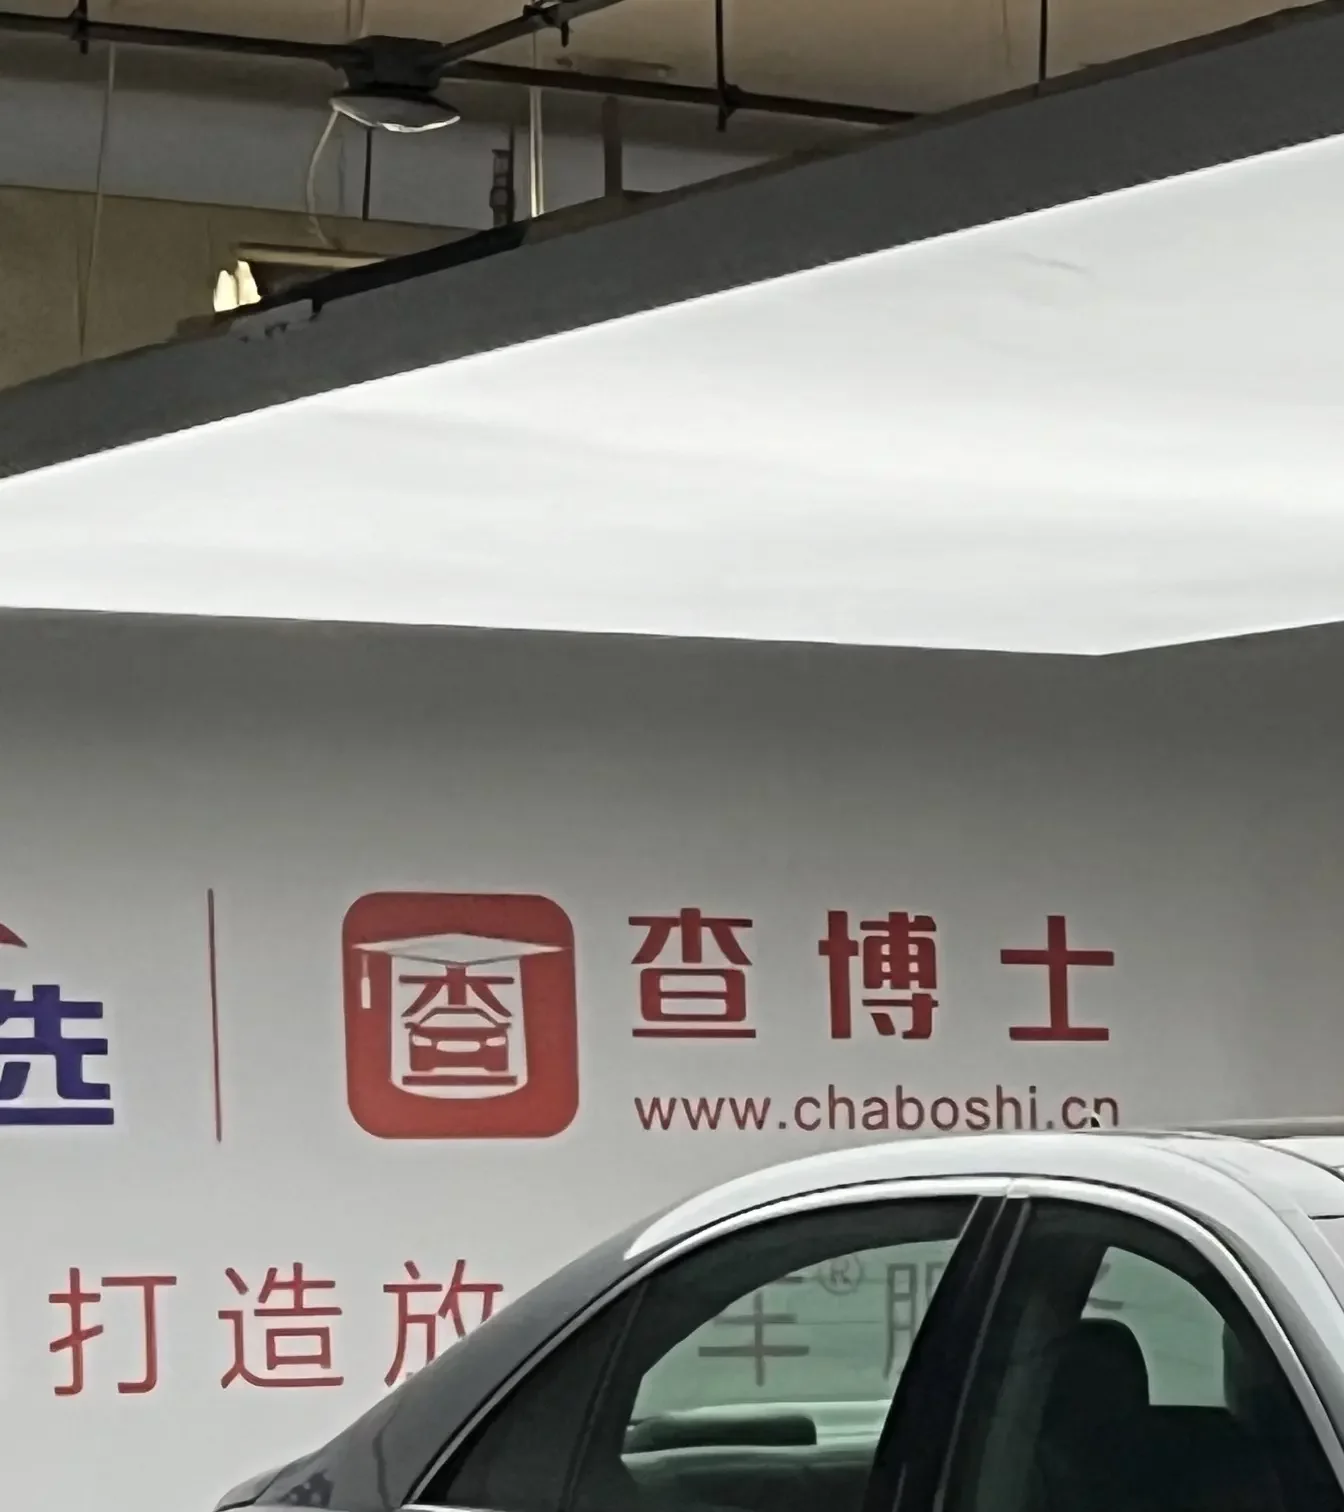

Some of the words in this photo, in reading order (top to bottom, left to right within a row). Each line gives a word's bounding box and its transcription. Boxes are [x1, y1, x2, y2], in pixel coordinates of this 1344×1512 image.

[628, 907, 1115, 1042] 查博士
[633, 1084, 1120, 1132] www.chaboshi.cn
